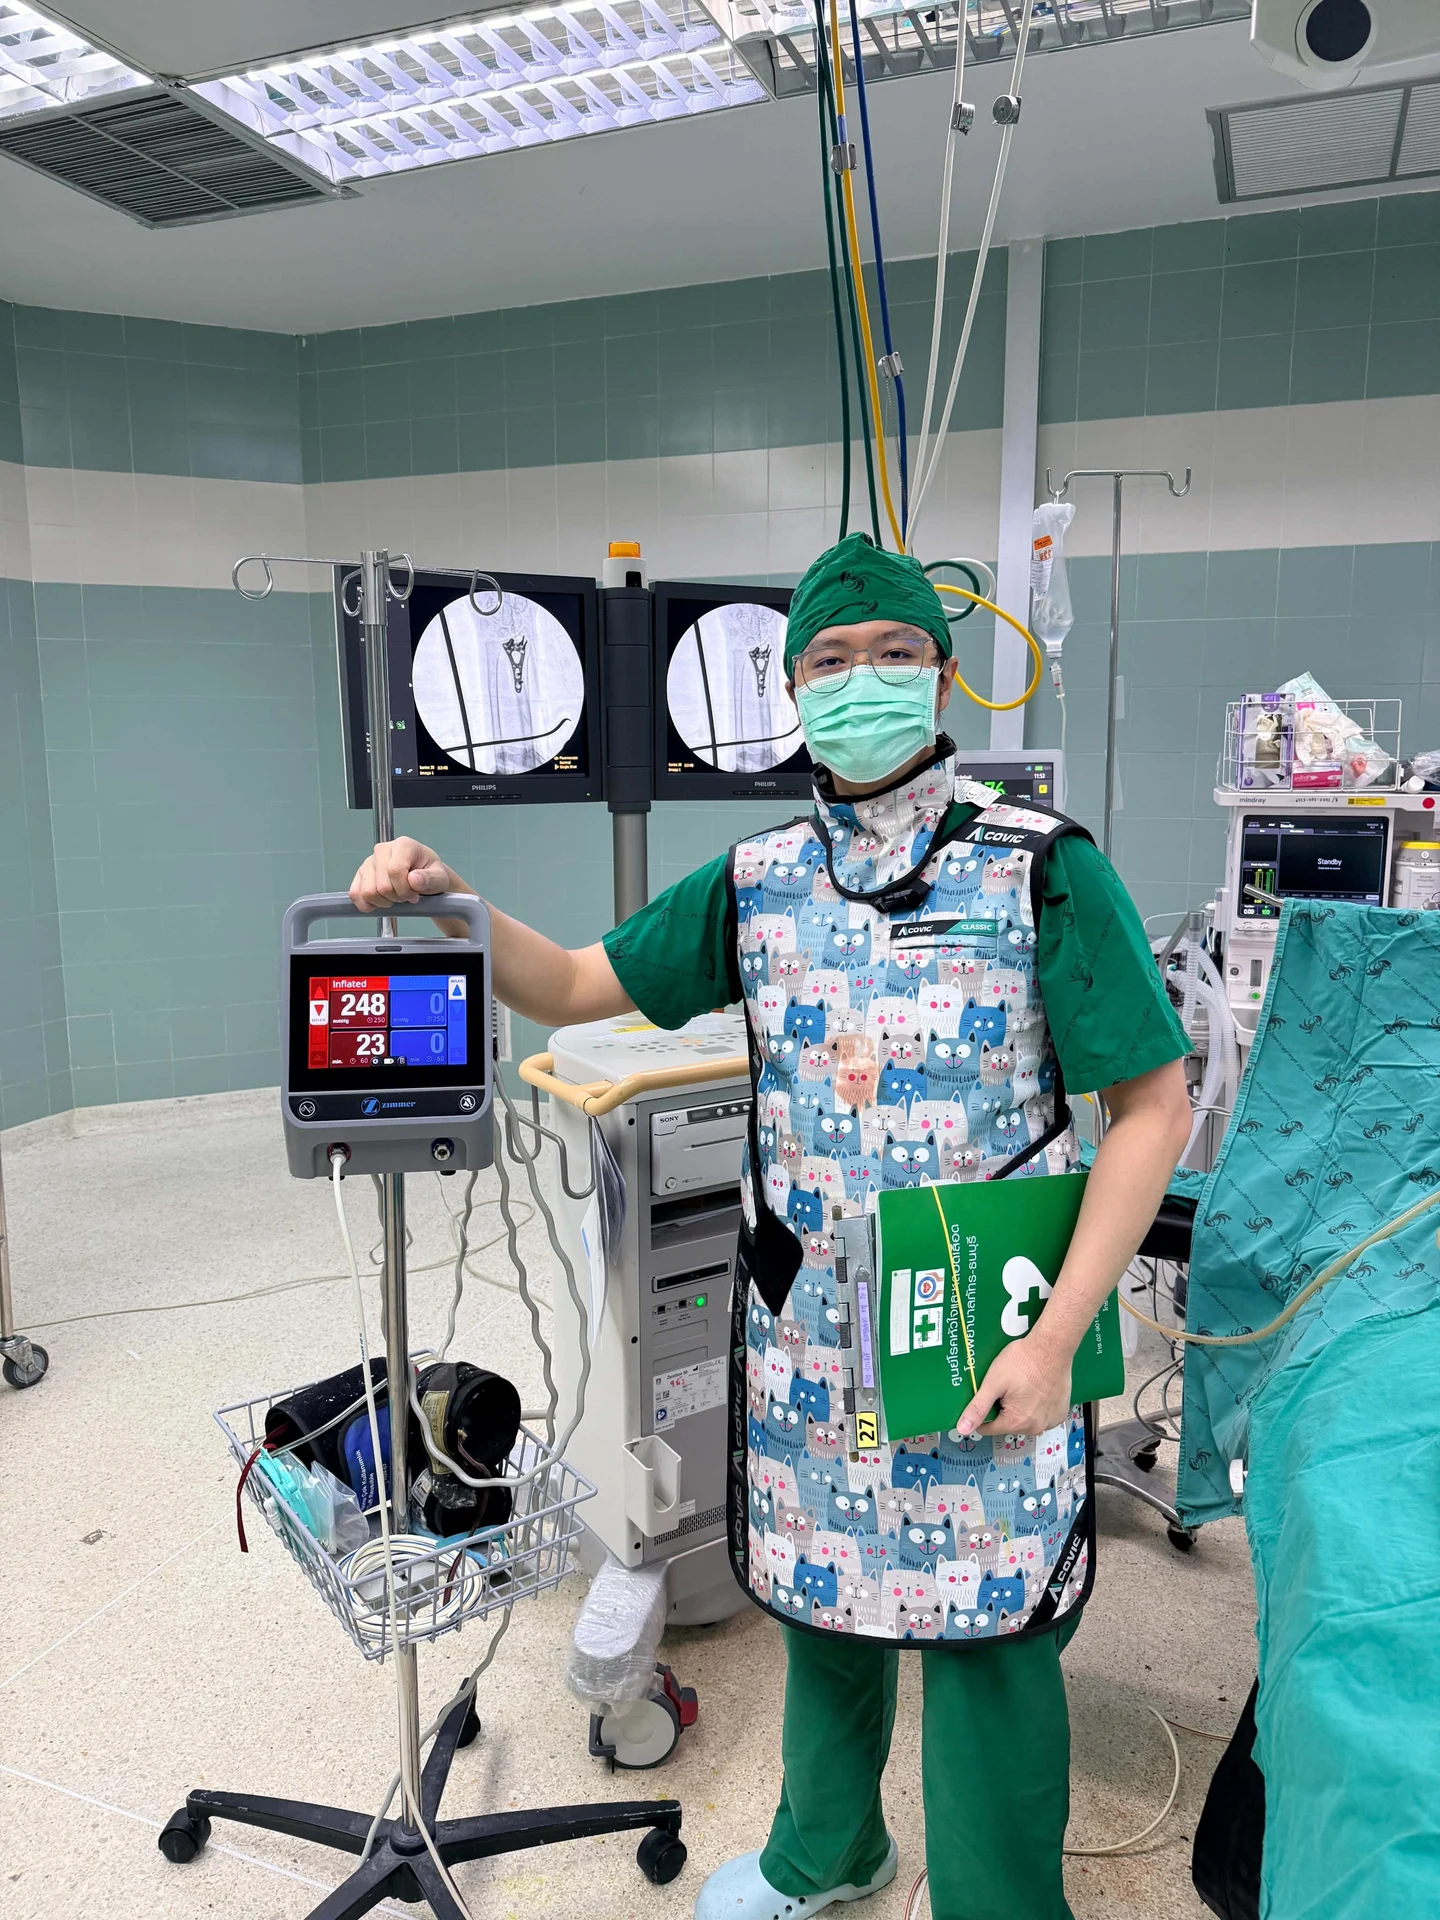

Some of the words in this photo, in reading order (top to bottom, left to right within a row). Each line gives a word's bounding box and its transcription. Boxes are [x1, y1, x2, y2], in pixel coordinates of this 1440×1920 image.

[1317, 858, 1342, 866] Standby
[961, 923, 992, 932] CLASSIC
[332, 979, 367, 988] Inflated
[340, 993, 386, 1016] 248
[429, 992, 444, 1015] 0
[356, 1033, 385, 1056] 23
[430, 1032, 445, 1054] 0
[382, 1101, 416, 1109] zimmer
[659, 1115, 679, 1123] SONY
[858, 1418, 875, 1442] 27
